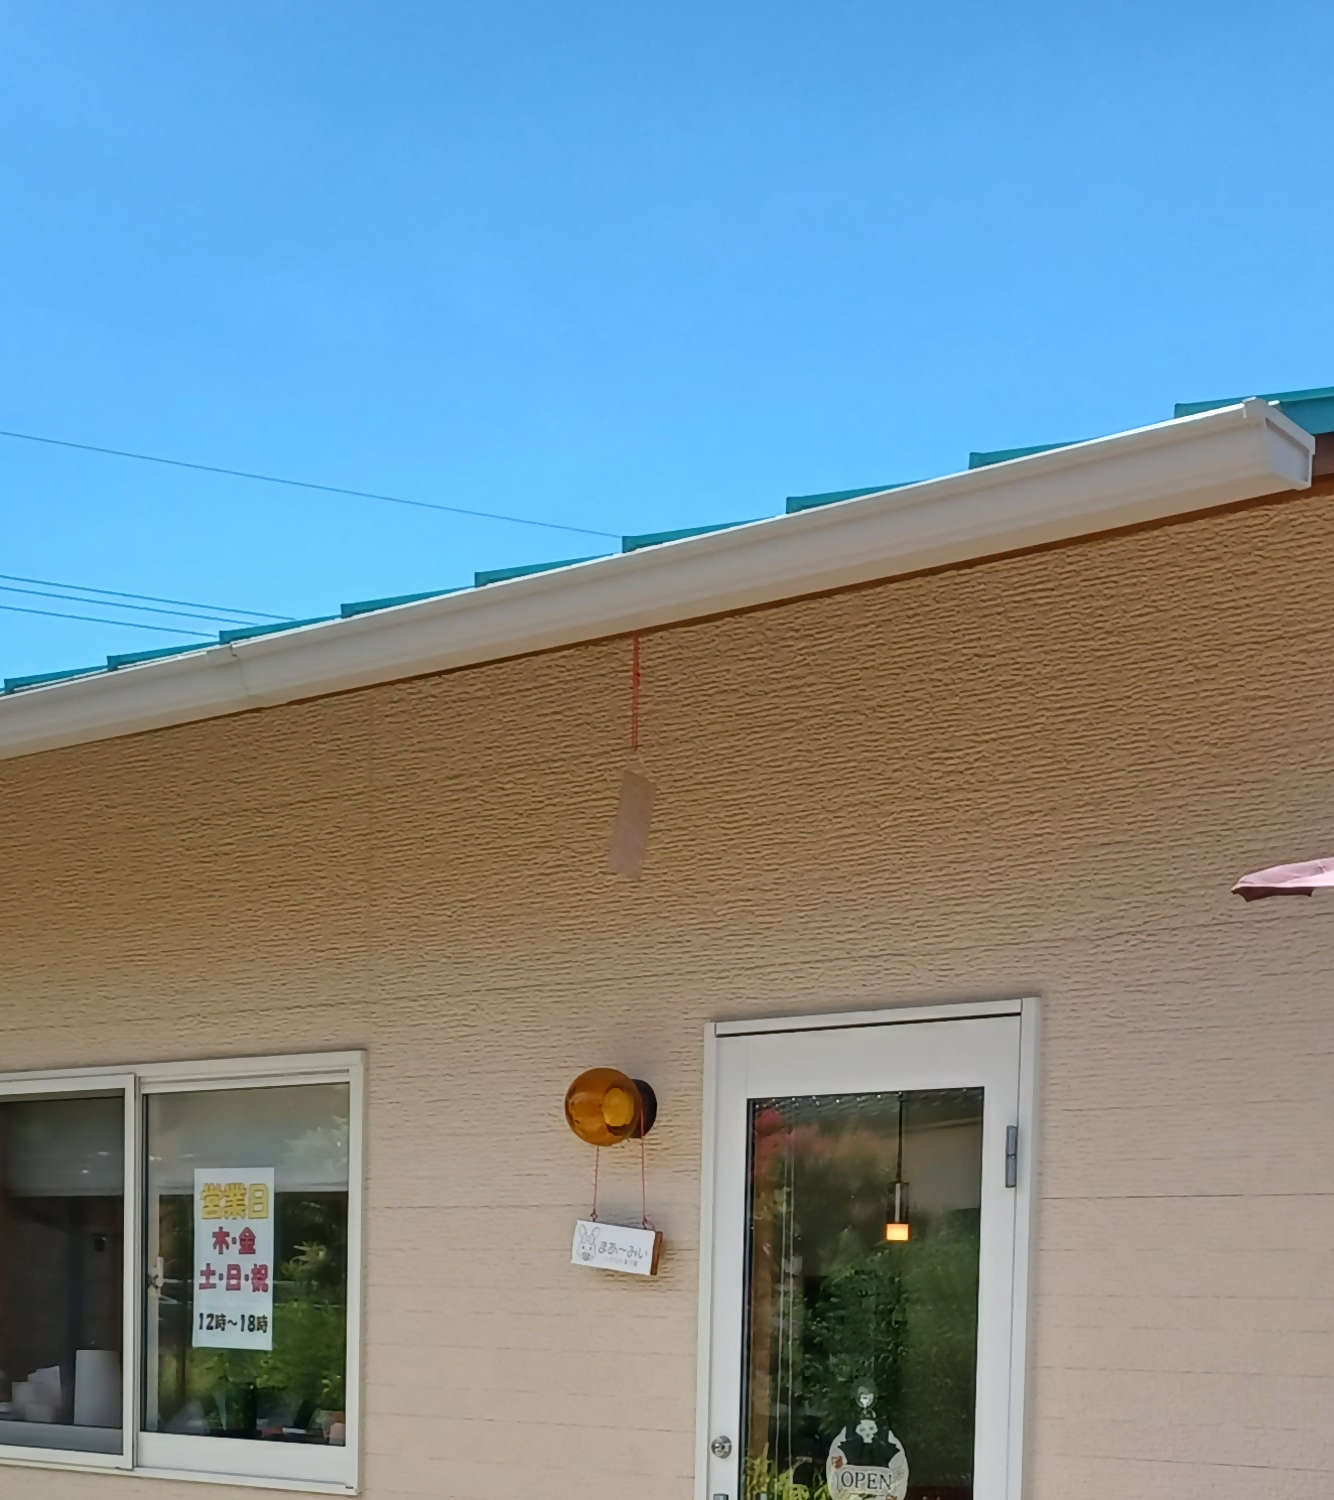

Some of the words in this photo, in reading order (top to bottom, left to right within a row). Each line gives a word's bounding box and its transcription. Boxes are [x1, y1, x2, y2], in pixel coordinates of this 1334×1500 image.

[201, 1182, 269, 1220] 営業日
[212, 1226, 256, 1255] 木・金
[840, 1470, 892, 1491] OPEN
